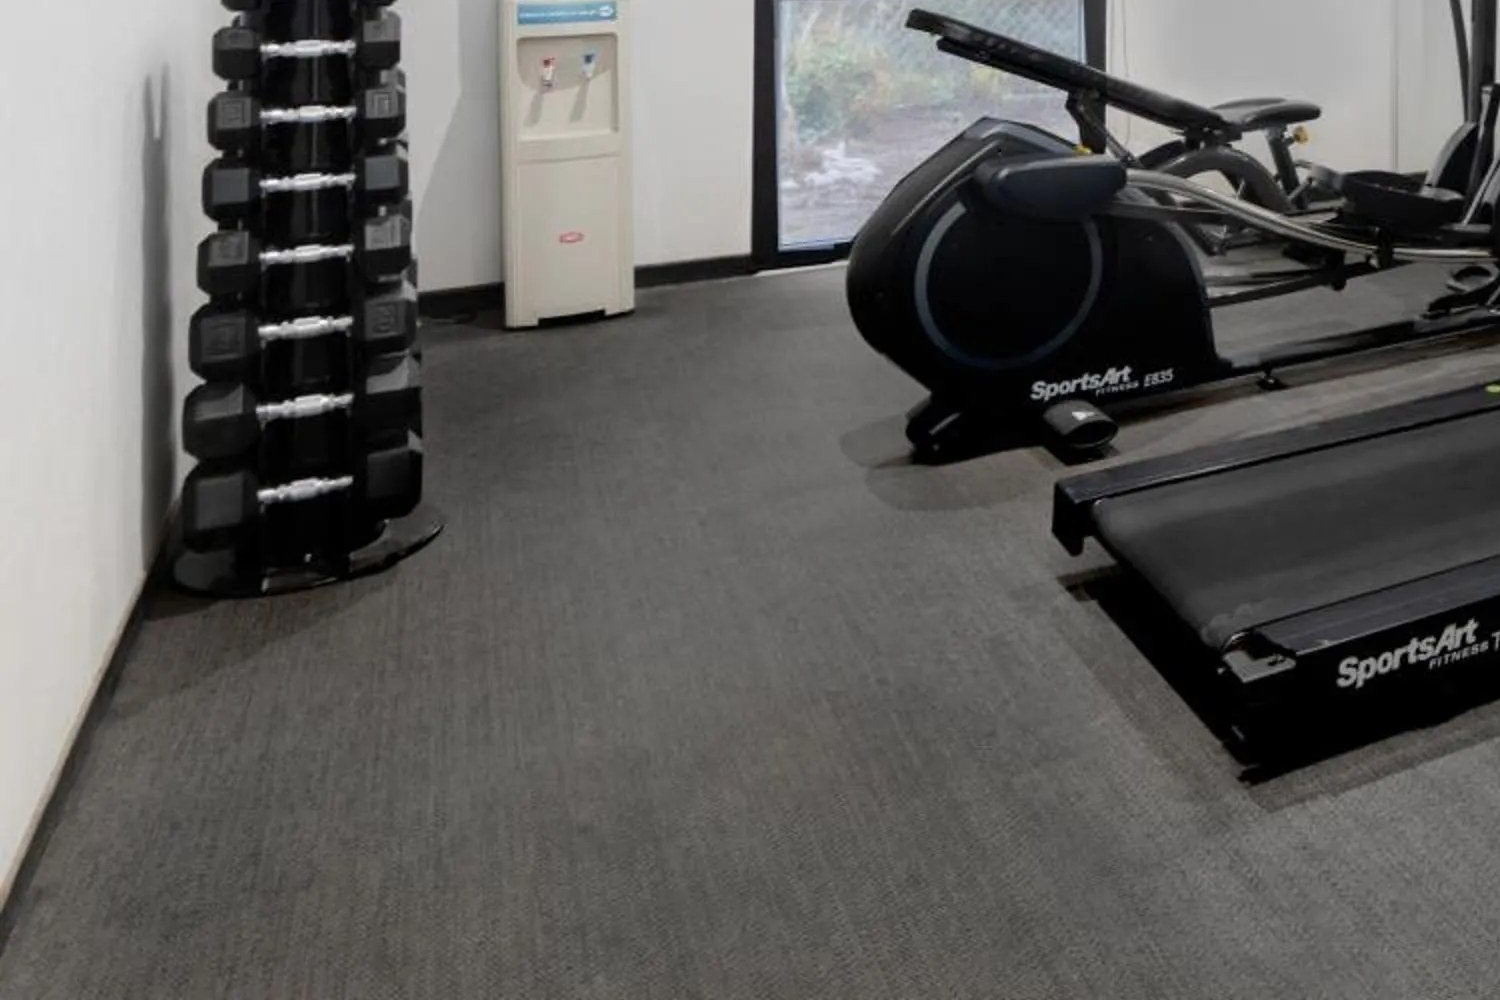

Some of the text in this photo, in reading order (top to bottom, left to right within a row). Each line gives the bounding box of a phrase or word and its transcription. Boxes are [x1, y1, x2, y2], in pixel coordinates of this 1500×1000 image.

[1030, 366, 1132, 401] SportsArt
[1336, 618, 1479, 689] SportsArt
[1428, 640, 1489, 671] FITNESS
